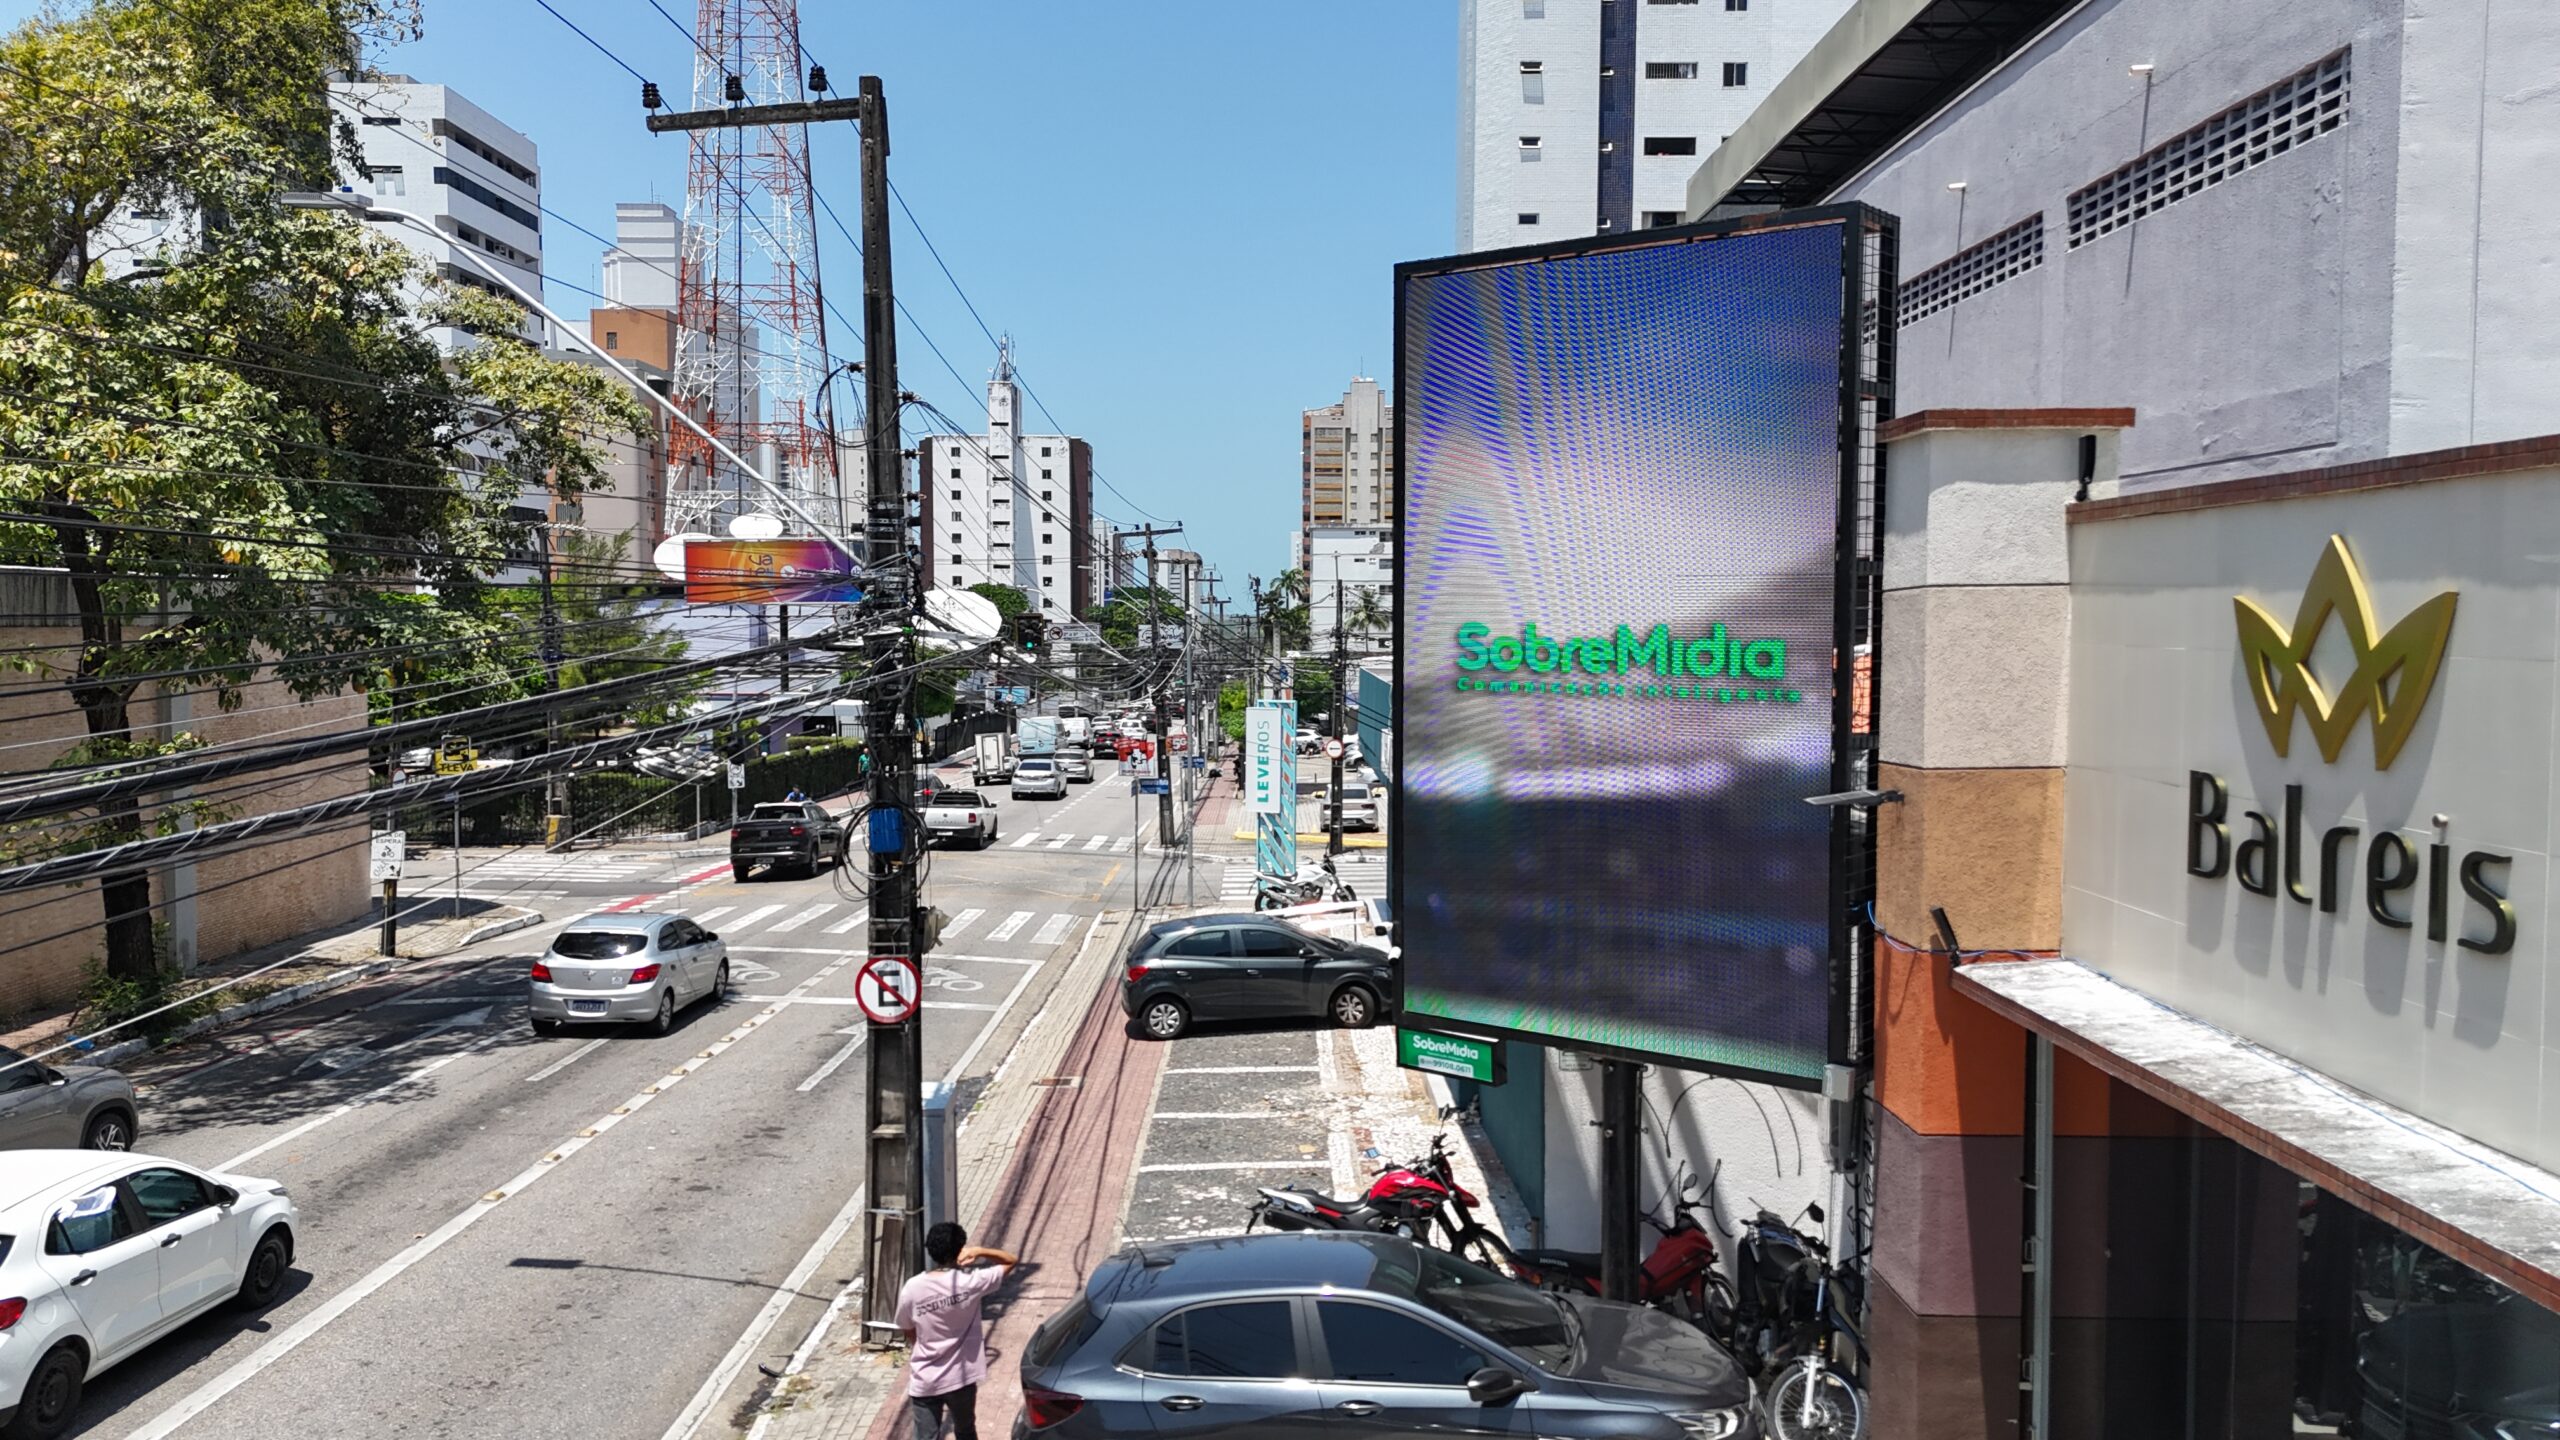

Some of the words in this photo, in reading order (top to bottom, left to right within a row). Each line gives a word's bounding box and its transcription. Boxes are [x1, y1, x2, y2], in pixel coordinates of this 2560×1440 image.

[1457, 621, 1786, 680] SobreMidia
[1257, 720, 1270, 803] LEVEROS
[2186, 769, 2518, 955] Balreis
[878, 970, 901, 1007] E
[1412, 1034, 1479, 1060] SobreMidia
